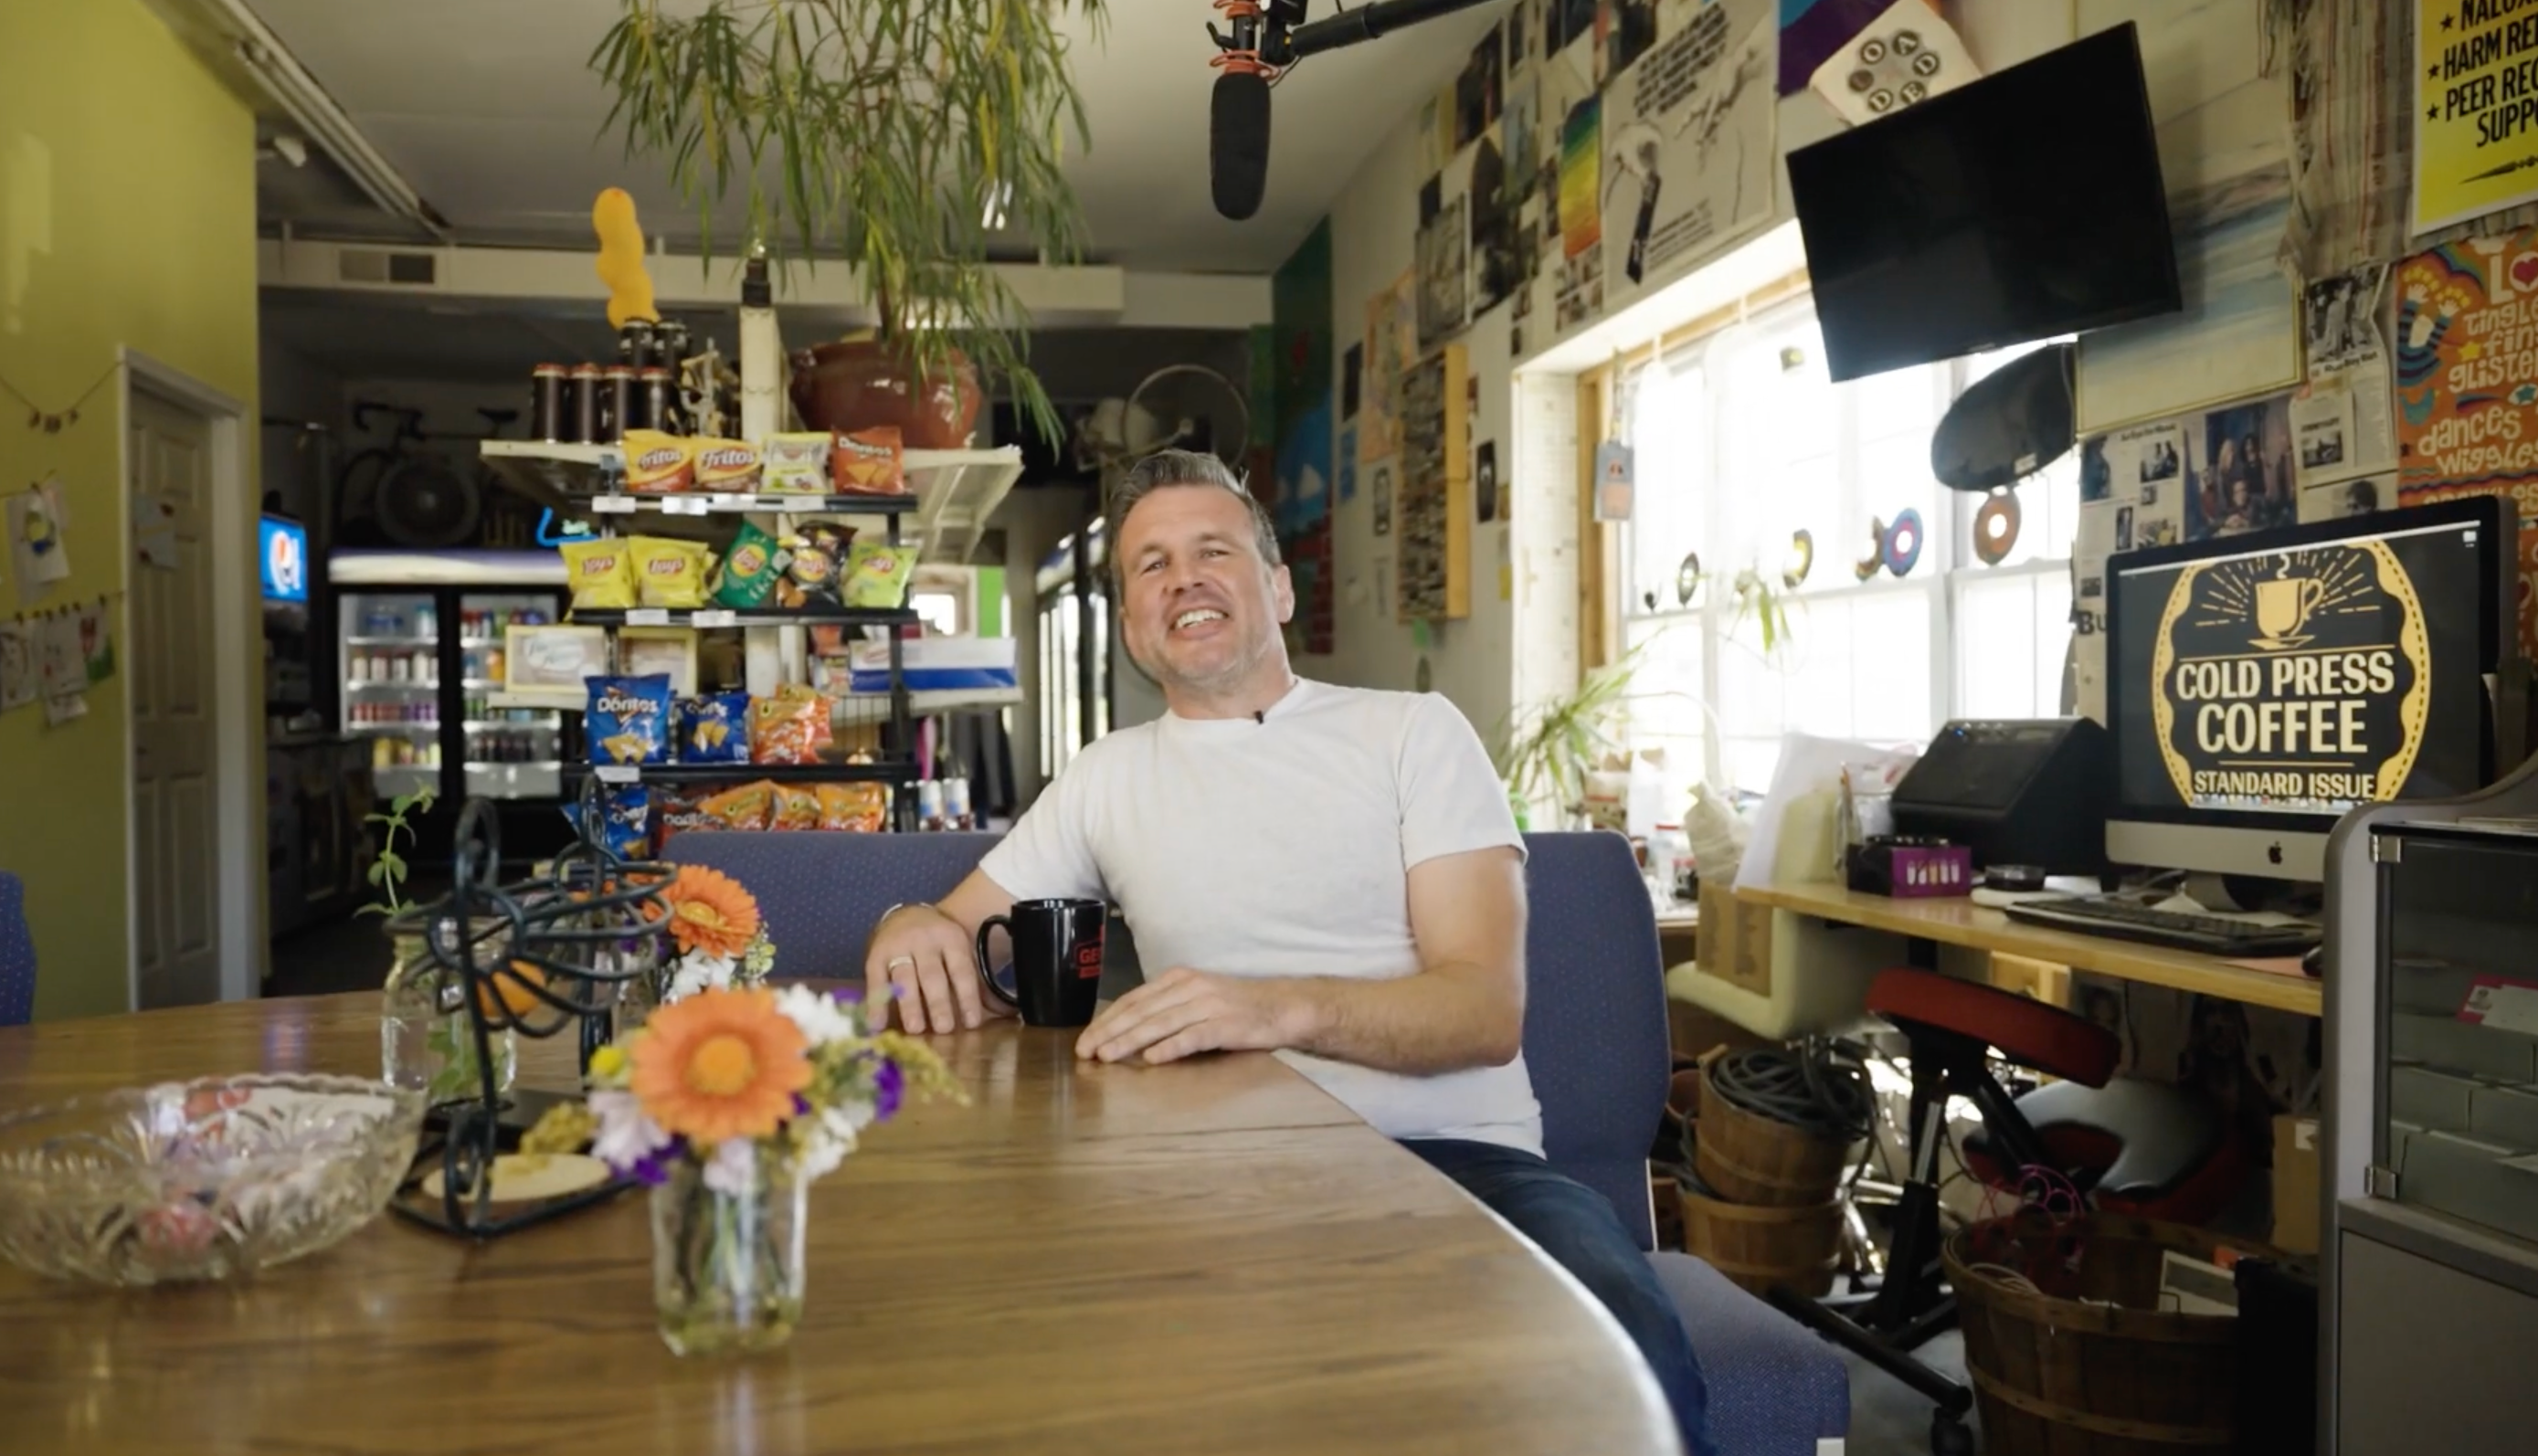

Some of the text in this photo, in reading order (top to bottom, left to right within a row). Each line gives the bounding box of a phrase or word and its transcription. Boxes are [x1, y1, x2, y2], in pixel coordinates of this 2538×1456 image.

[2443, 26, 2501, 81] HARM
[2446, 74, 2495, 121] PEER
[2477, 96, 2538, 148] SUPP
[2482, 322, 2538, 356] fin
[2176, 650, 2395, 700] COLD PRESS
[597, 696, 660, 713] Doritos
[2197, 700, 2368, 754] COFFEE
[2194, 770, 2374, 798] STANDARD ISSUE
